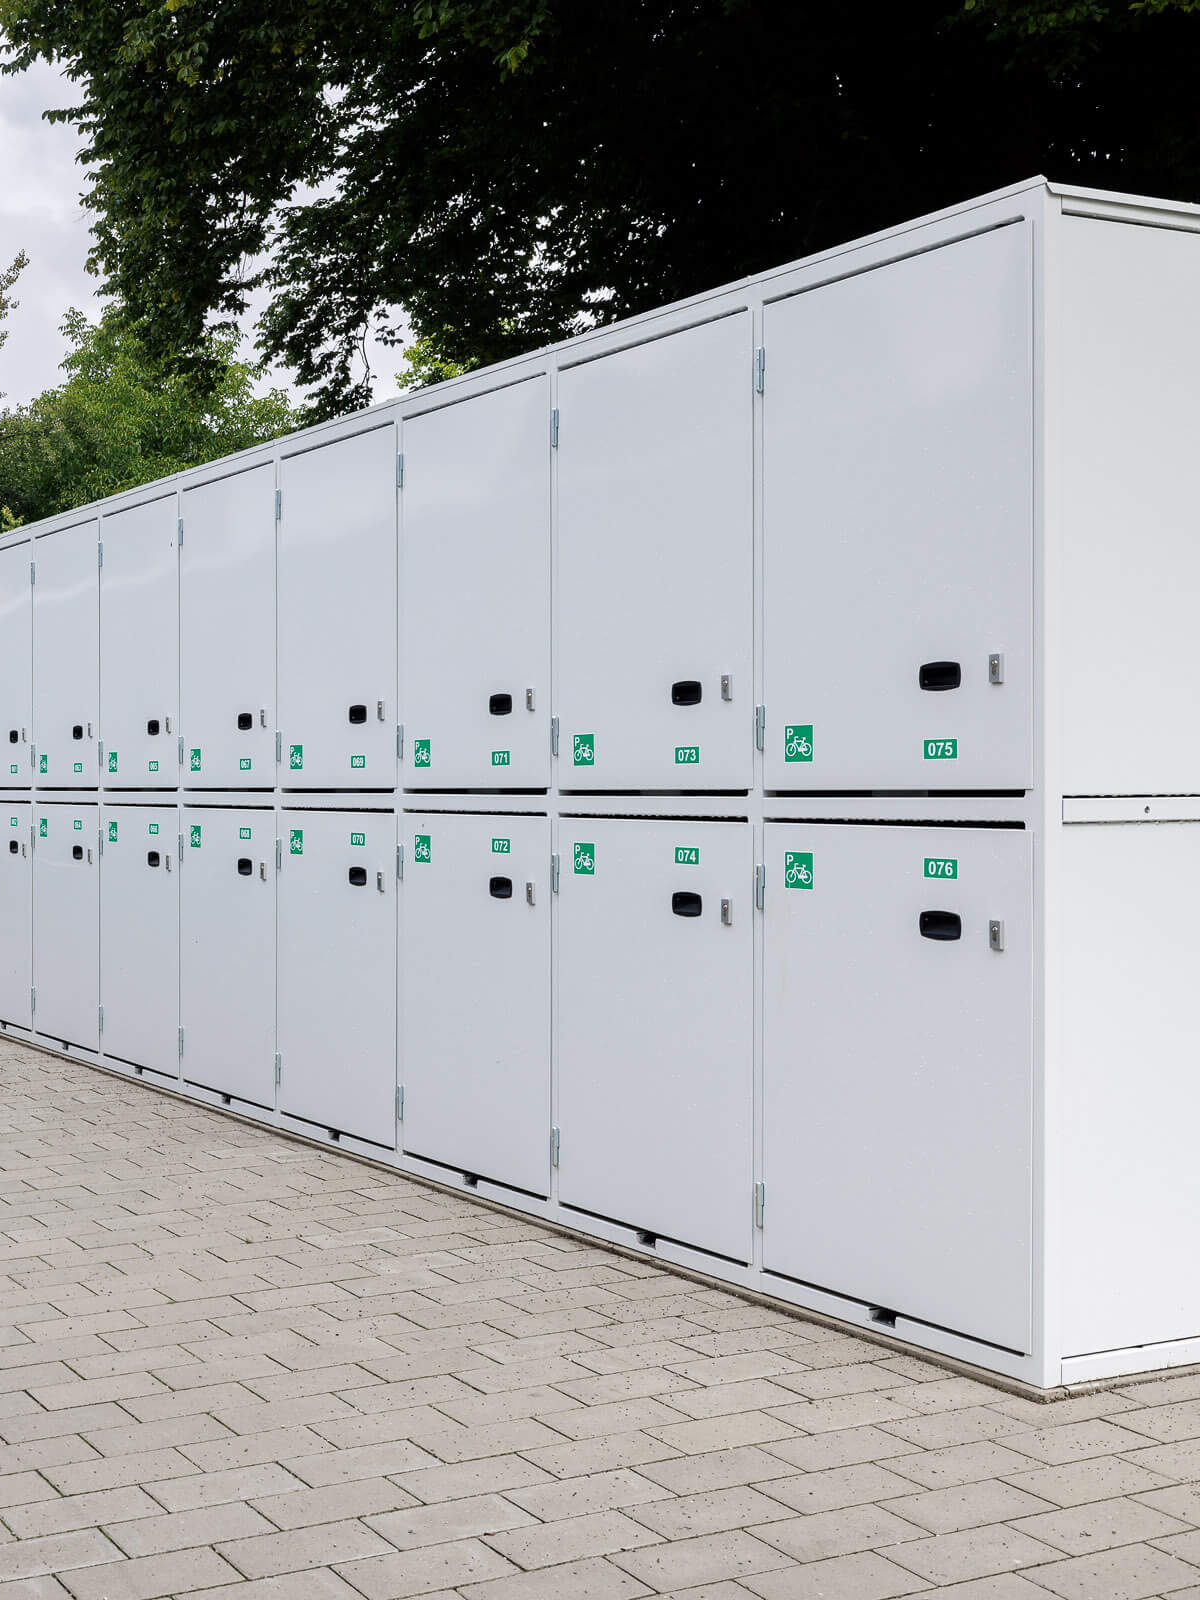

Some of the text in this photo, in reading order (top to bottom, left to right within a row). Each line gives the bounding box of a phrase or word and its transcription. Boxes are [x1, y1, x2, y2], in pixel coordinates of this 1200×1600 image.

[786, 728, 794, 740] P
[928, 742, 953, 756] 075
[494, 752, 508, 764] 071
[678, 749, 696, 762] 073
[494, 840, 508, 852] 072
[678, 850, 696, 862] 074
[786, 854, 794, 866] P
[928, 861, 953, 876] 076
